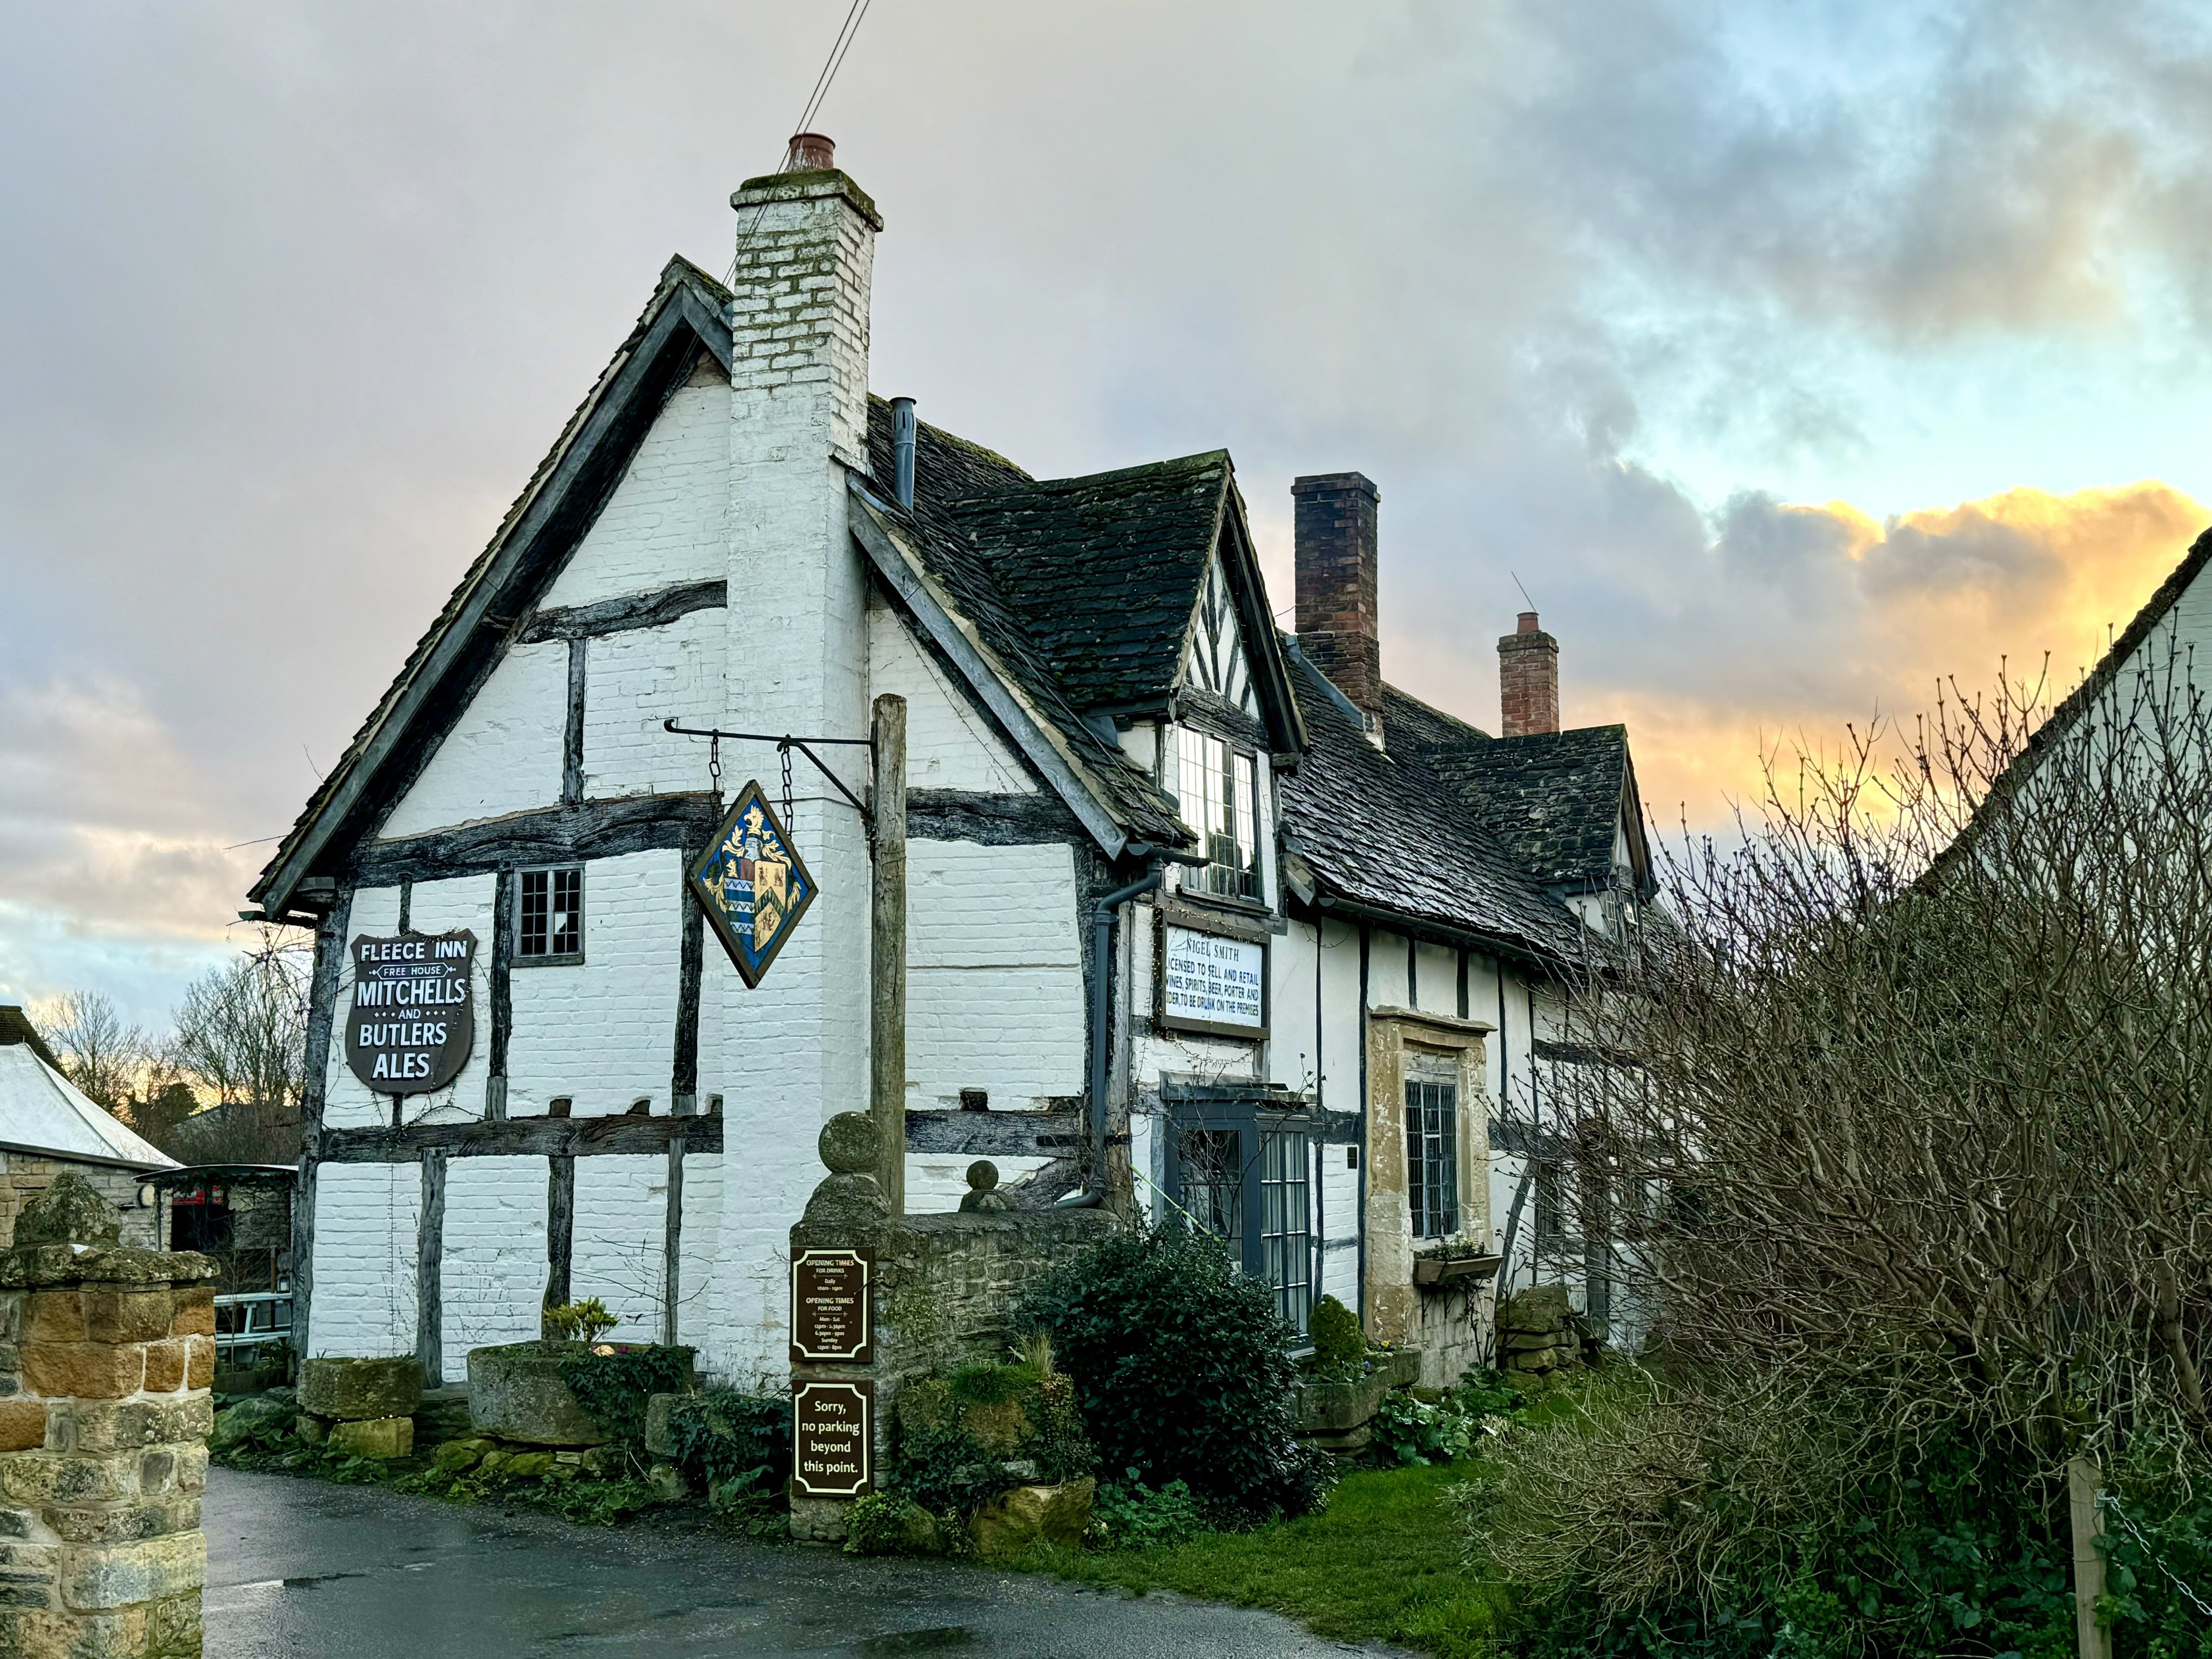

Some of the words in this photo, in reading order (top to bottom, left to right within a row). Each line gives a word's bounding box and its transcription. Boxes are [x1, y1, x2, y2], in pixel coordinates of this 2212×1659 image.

[361, 942, 424, 961] FLEECE
[435, 941, 467, 958] INN
[1187, 938, 1210, 956] NIGEL
[1214, 945, 1239, 961] SMITH
[383, 968, 406, 976] FREE
[412, 966, 441, 975] HOUSE
[1166, 957, 1195, 974] ICENSED
[1198, 963, 1205, 975] TO
[1208, 965, 1221, 979] SELL
[1224, 969, 1237, 981] AND
[1239, 972, 1258, 986] RETAIL
[357, 979, 466, 1006] MITCHELLS
[1185, 977, 1207, 995] SPIRITS,
[1224, 985, 1244, 999] PORTER
[1247, 989, 1258, 1001] AND
[398, 1009, 421, 1019] AND
[1166, 992, 1181, 1007] IDER,
[1190, 995, 1196, 1007] BE
[1197, 996, 1215, 1010] DRUNK
[1217, 1001, 1224, 1011] ON
[1226, 1001, 1236, 1013] THE
[1237, 1002, 1258, 1016] PREMISES
[359, 1022, 447, 1046] BUTLERS
[372, 1053, 429, 1078] ALES
[815, 1401, 846, 1415] Sorry,
[802, 1423, 815, 1431] no
[819, 1420, 860, 1436] parking
[811, 1440, 851, 1454] beyond
[804, 1460, 824, 1472] this
[827, 1461, 858, 1475] point.
